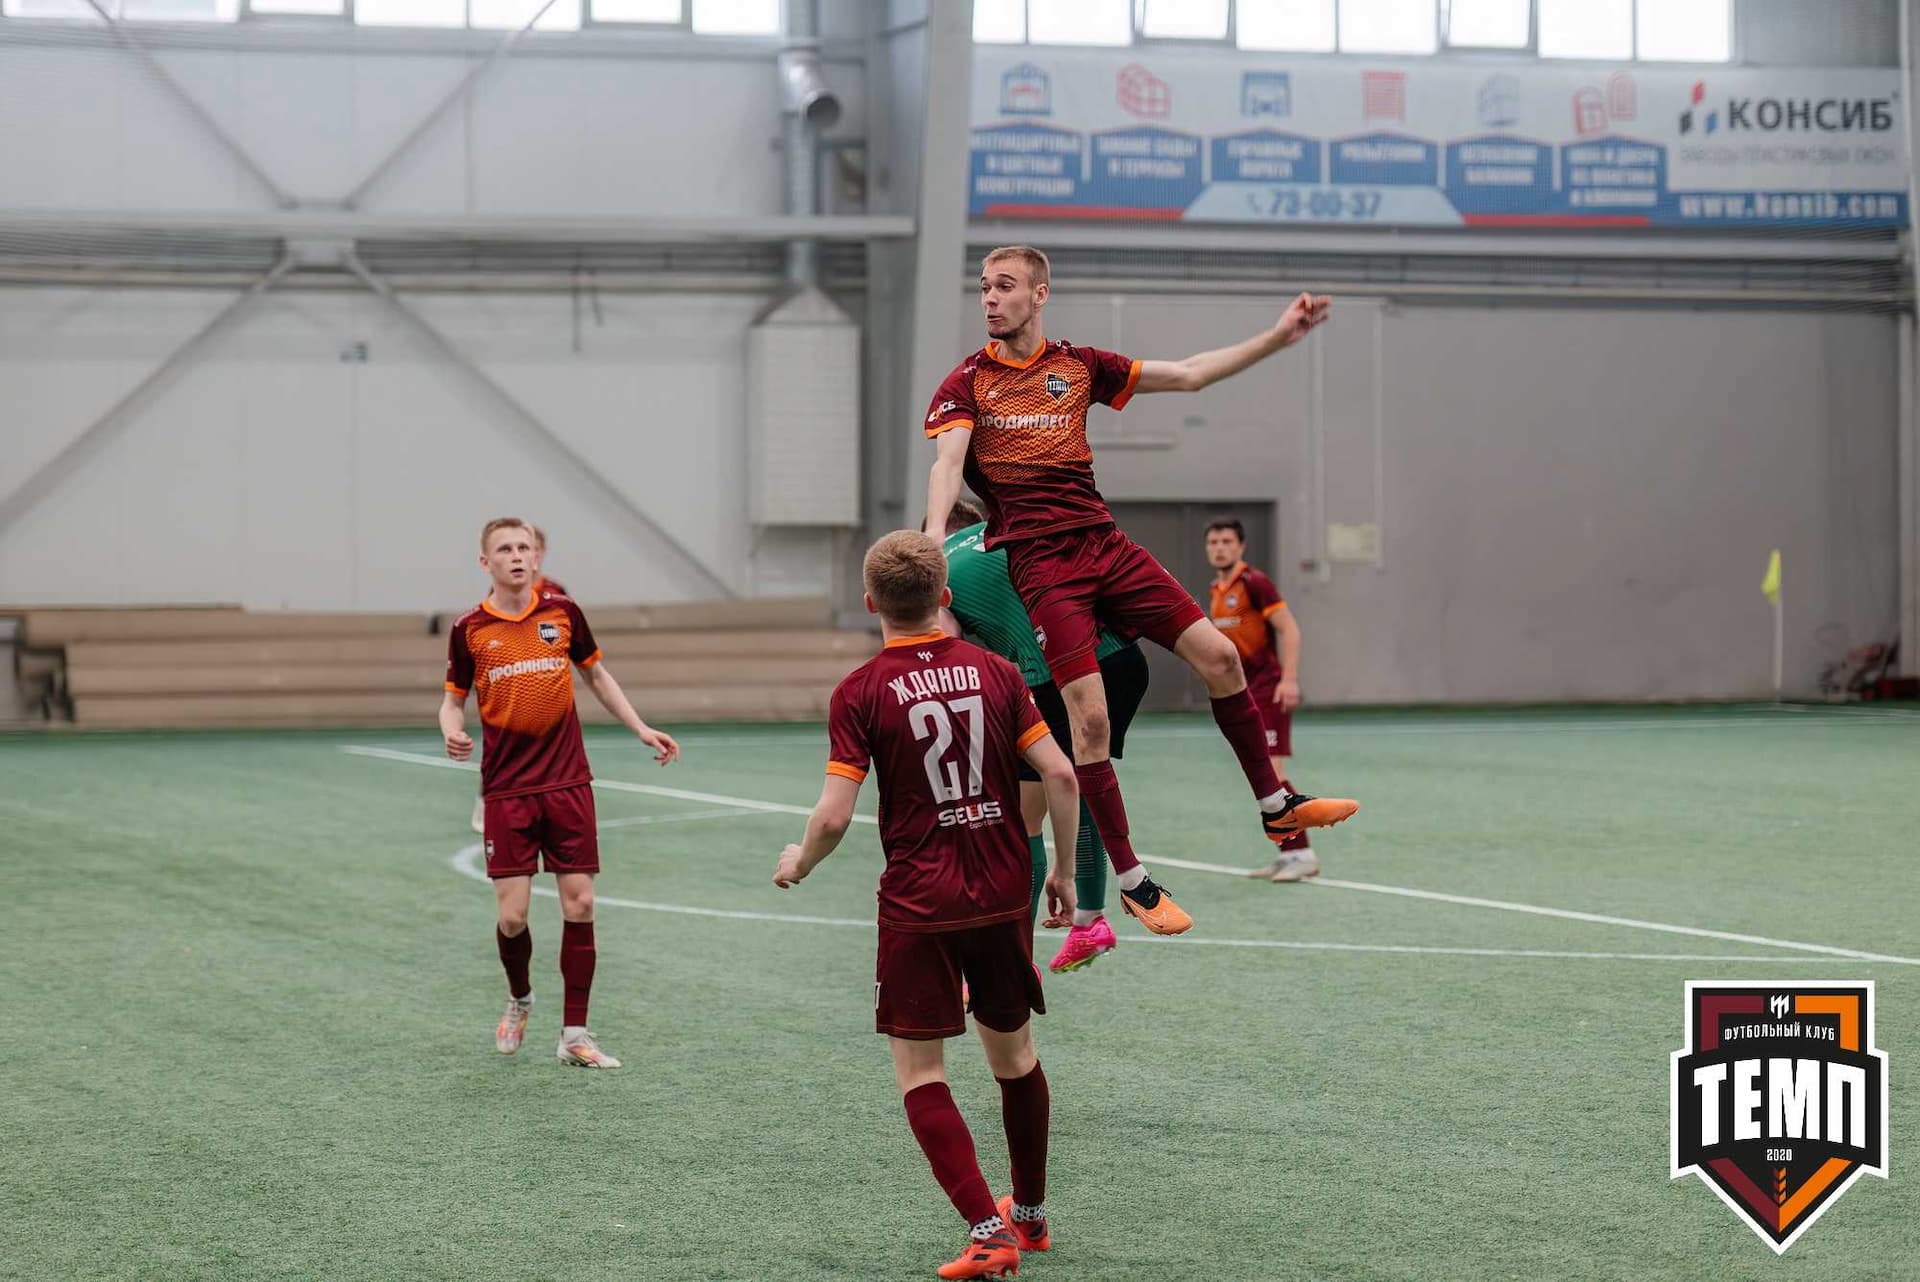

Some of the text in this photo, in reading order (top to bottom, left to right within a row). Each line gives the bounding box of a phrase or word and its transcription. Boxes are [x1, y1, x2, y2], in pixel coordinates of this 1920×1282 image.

[1728, 99, 1893, 131] КОНСИБ
[1269, 191, 1383, 217] 73-00-37
[887, 665, 982, 706] ЖДАНОВ
[908, 695, 985, 804] 27
[937, 801, 1002, 827] SEUS
